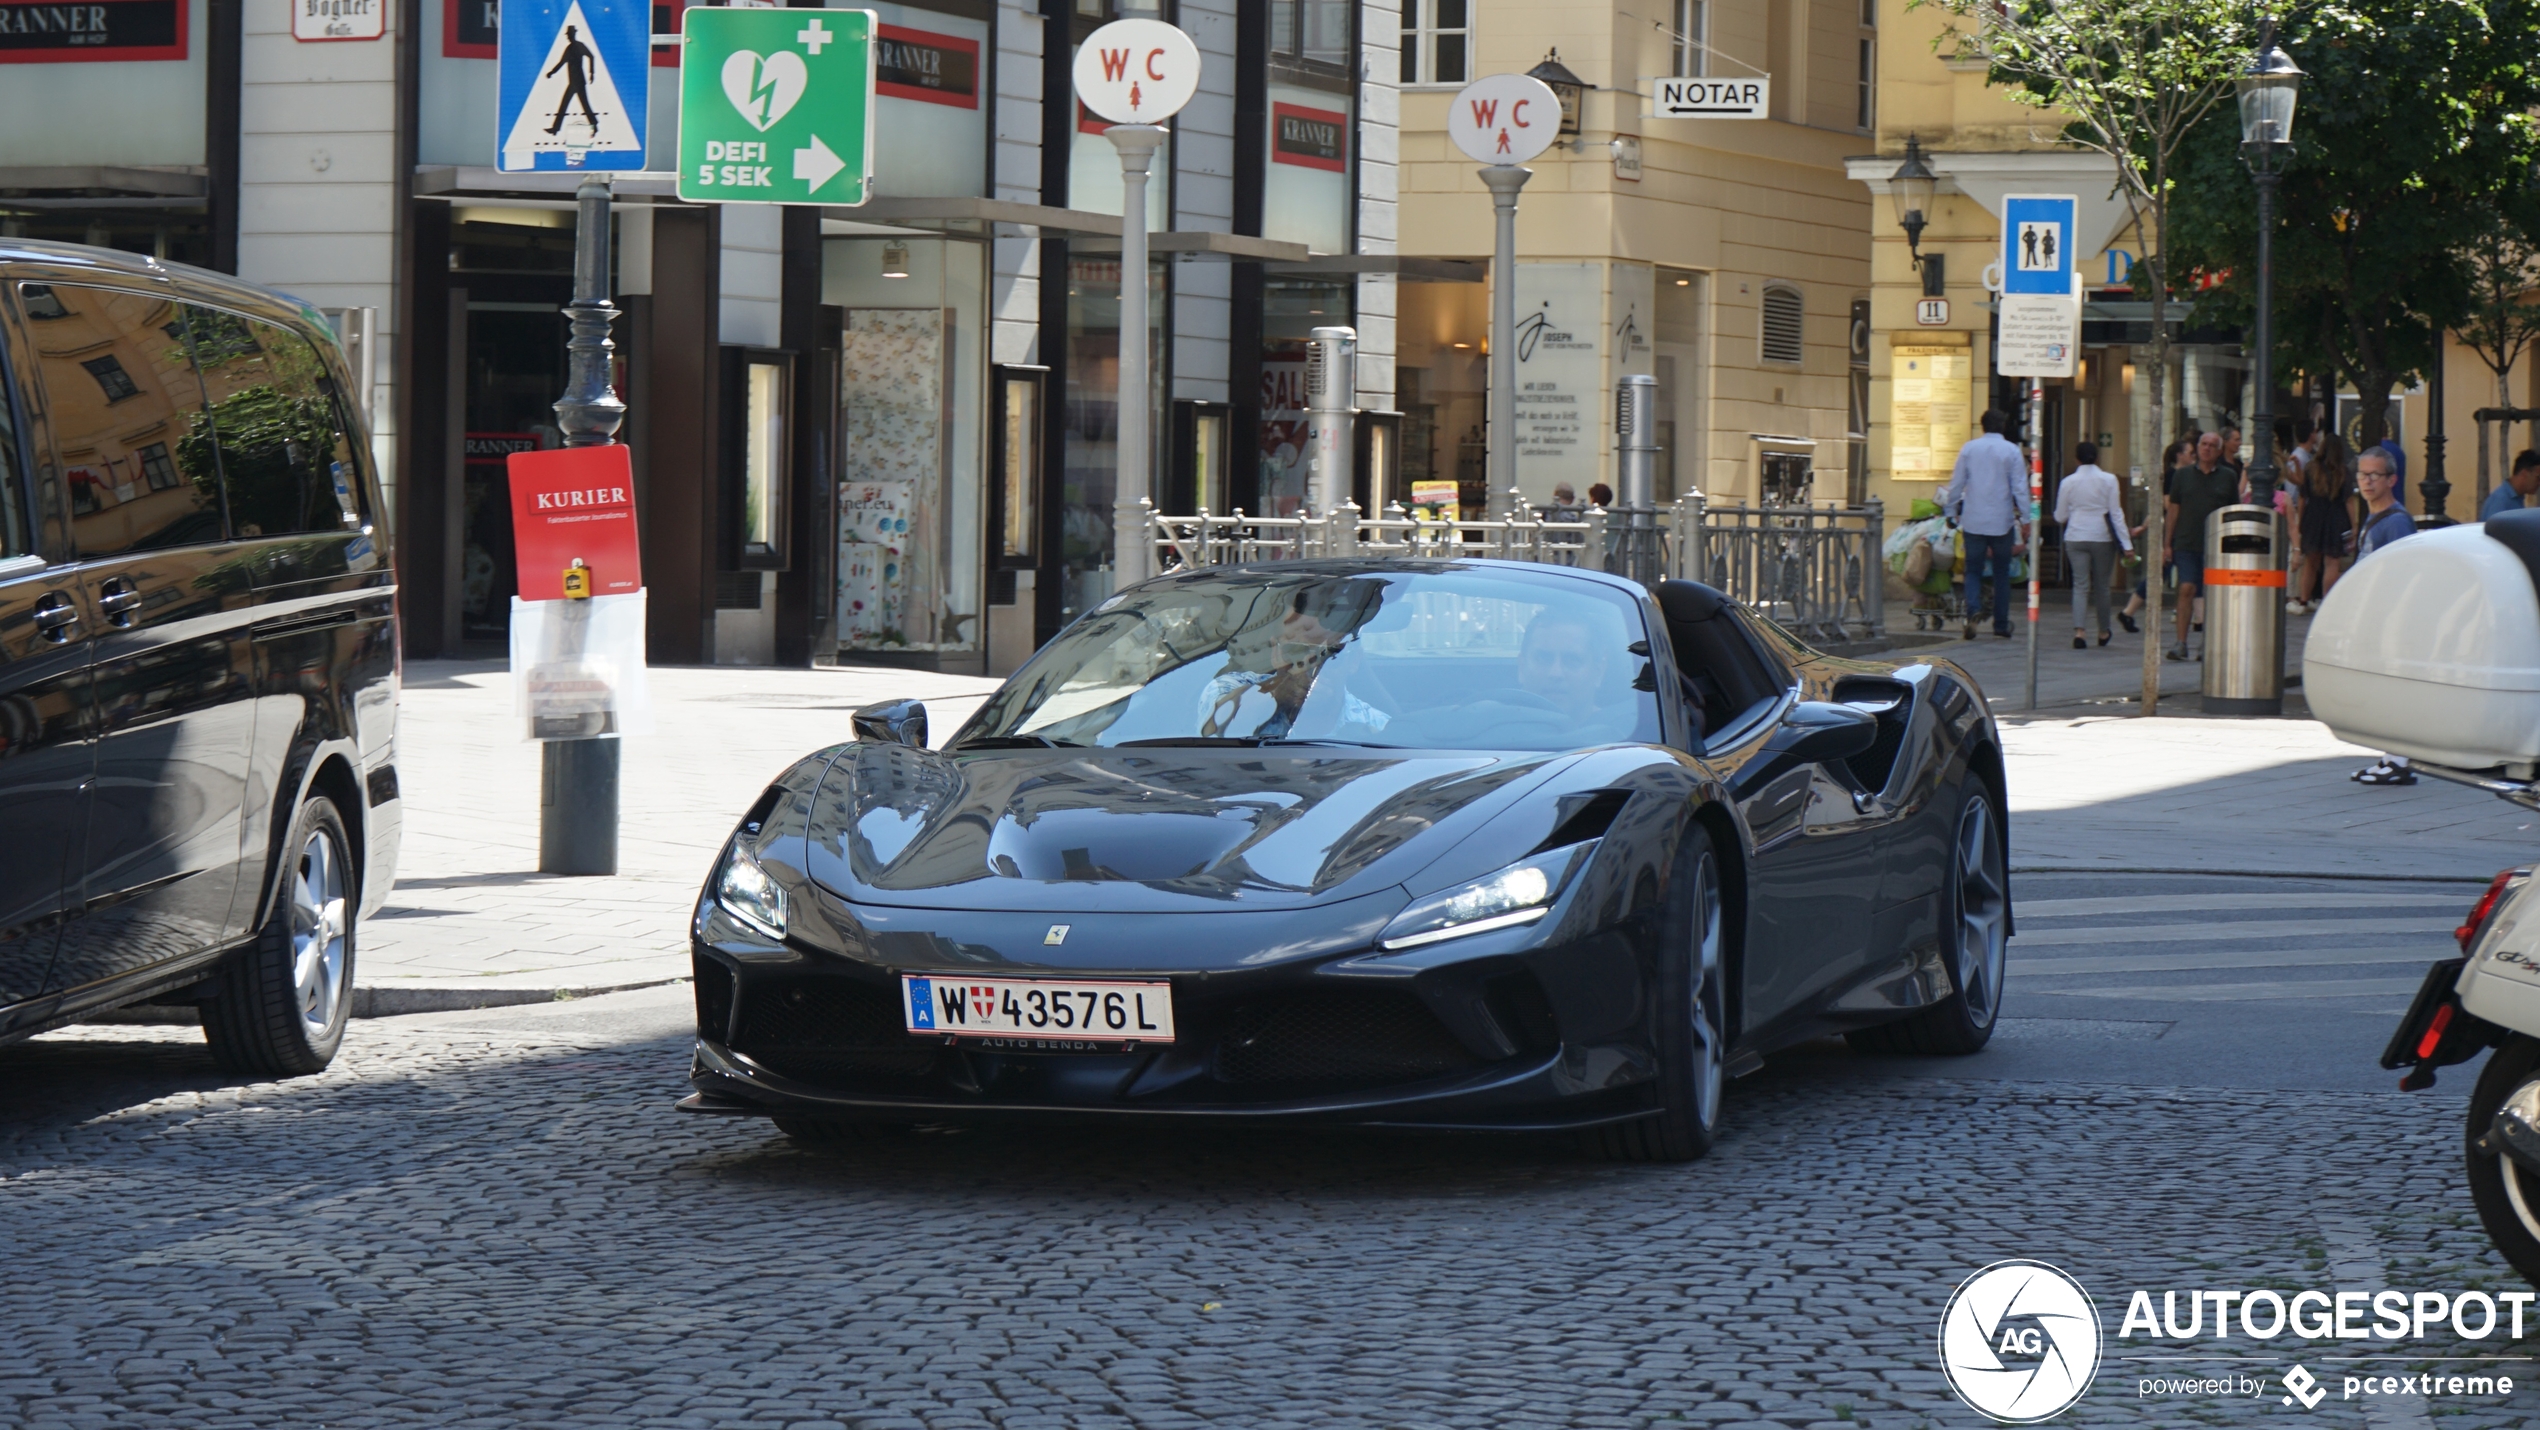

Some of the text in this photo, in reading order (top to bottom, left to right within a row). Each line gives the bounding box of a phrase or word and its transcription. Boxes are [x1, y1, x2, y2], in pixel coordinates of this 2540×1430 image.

[1665, 83, 1760, 104] NOTAR
[1284, 118, 1336, 147] KRANNER
[706, 141, 767, 162] DEFI
[698, 165, 773, 187] 5 SEK
[1926, 302, 1940, 317] 11
[1543, 332, 1573, 342] JOSEPH
[537, 487, 627, 509] KURIER
[918, 1010, 929, 1022] A
[939, 986, 966, 1024] W
[982, 1038, 1098, 1050] AUTO BENDA
